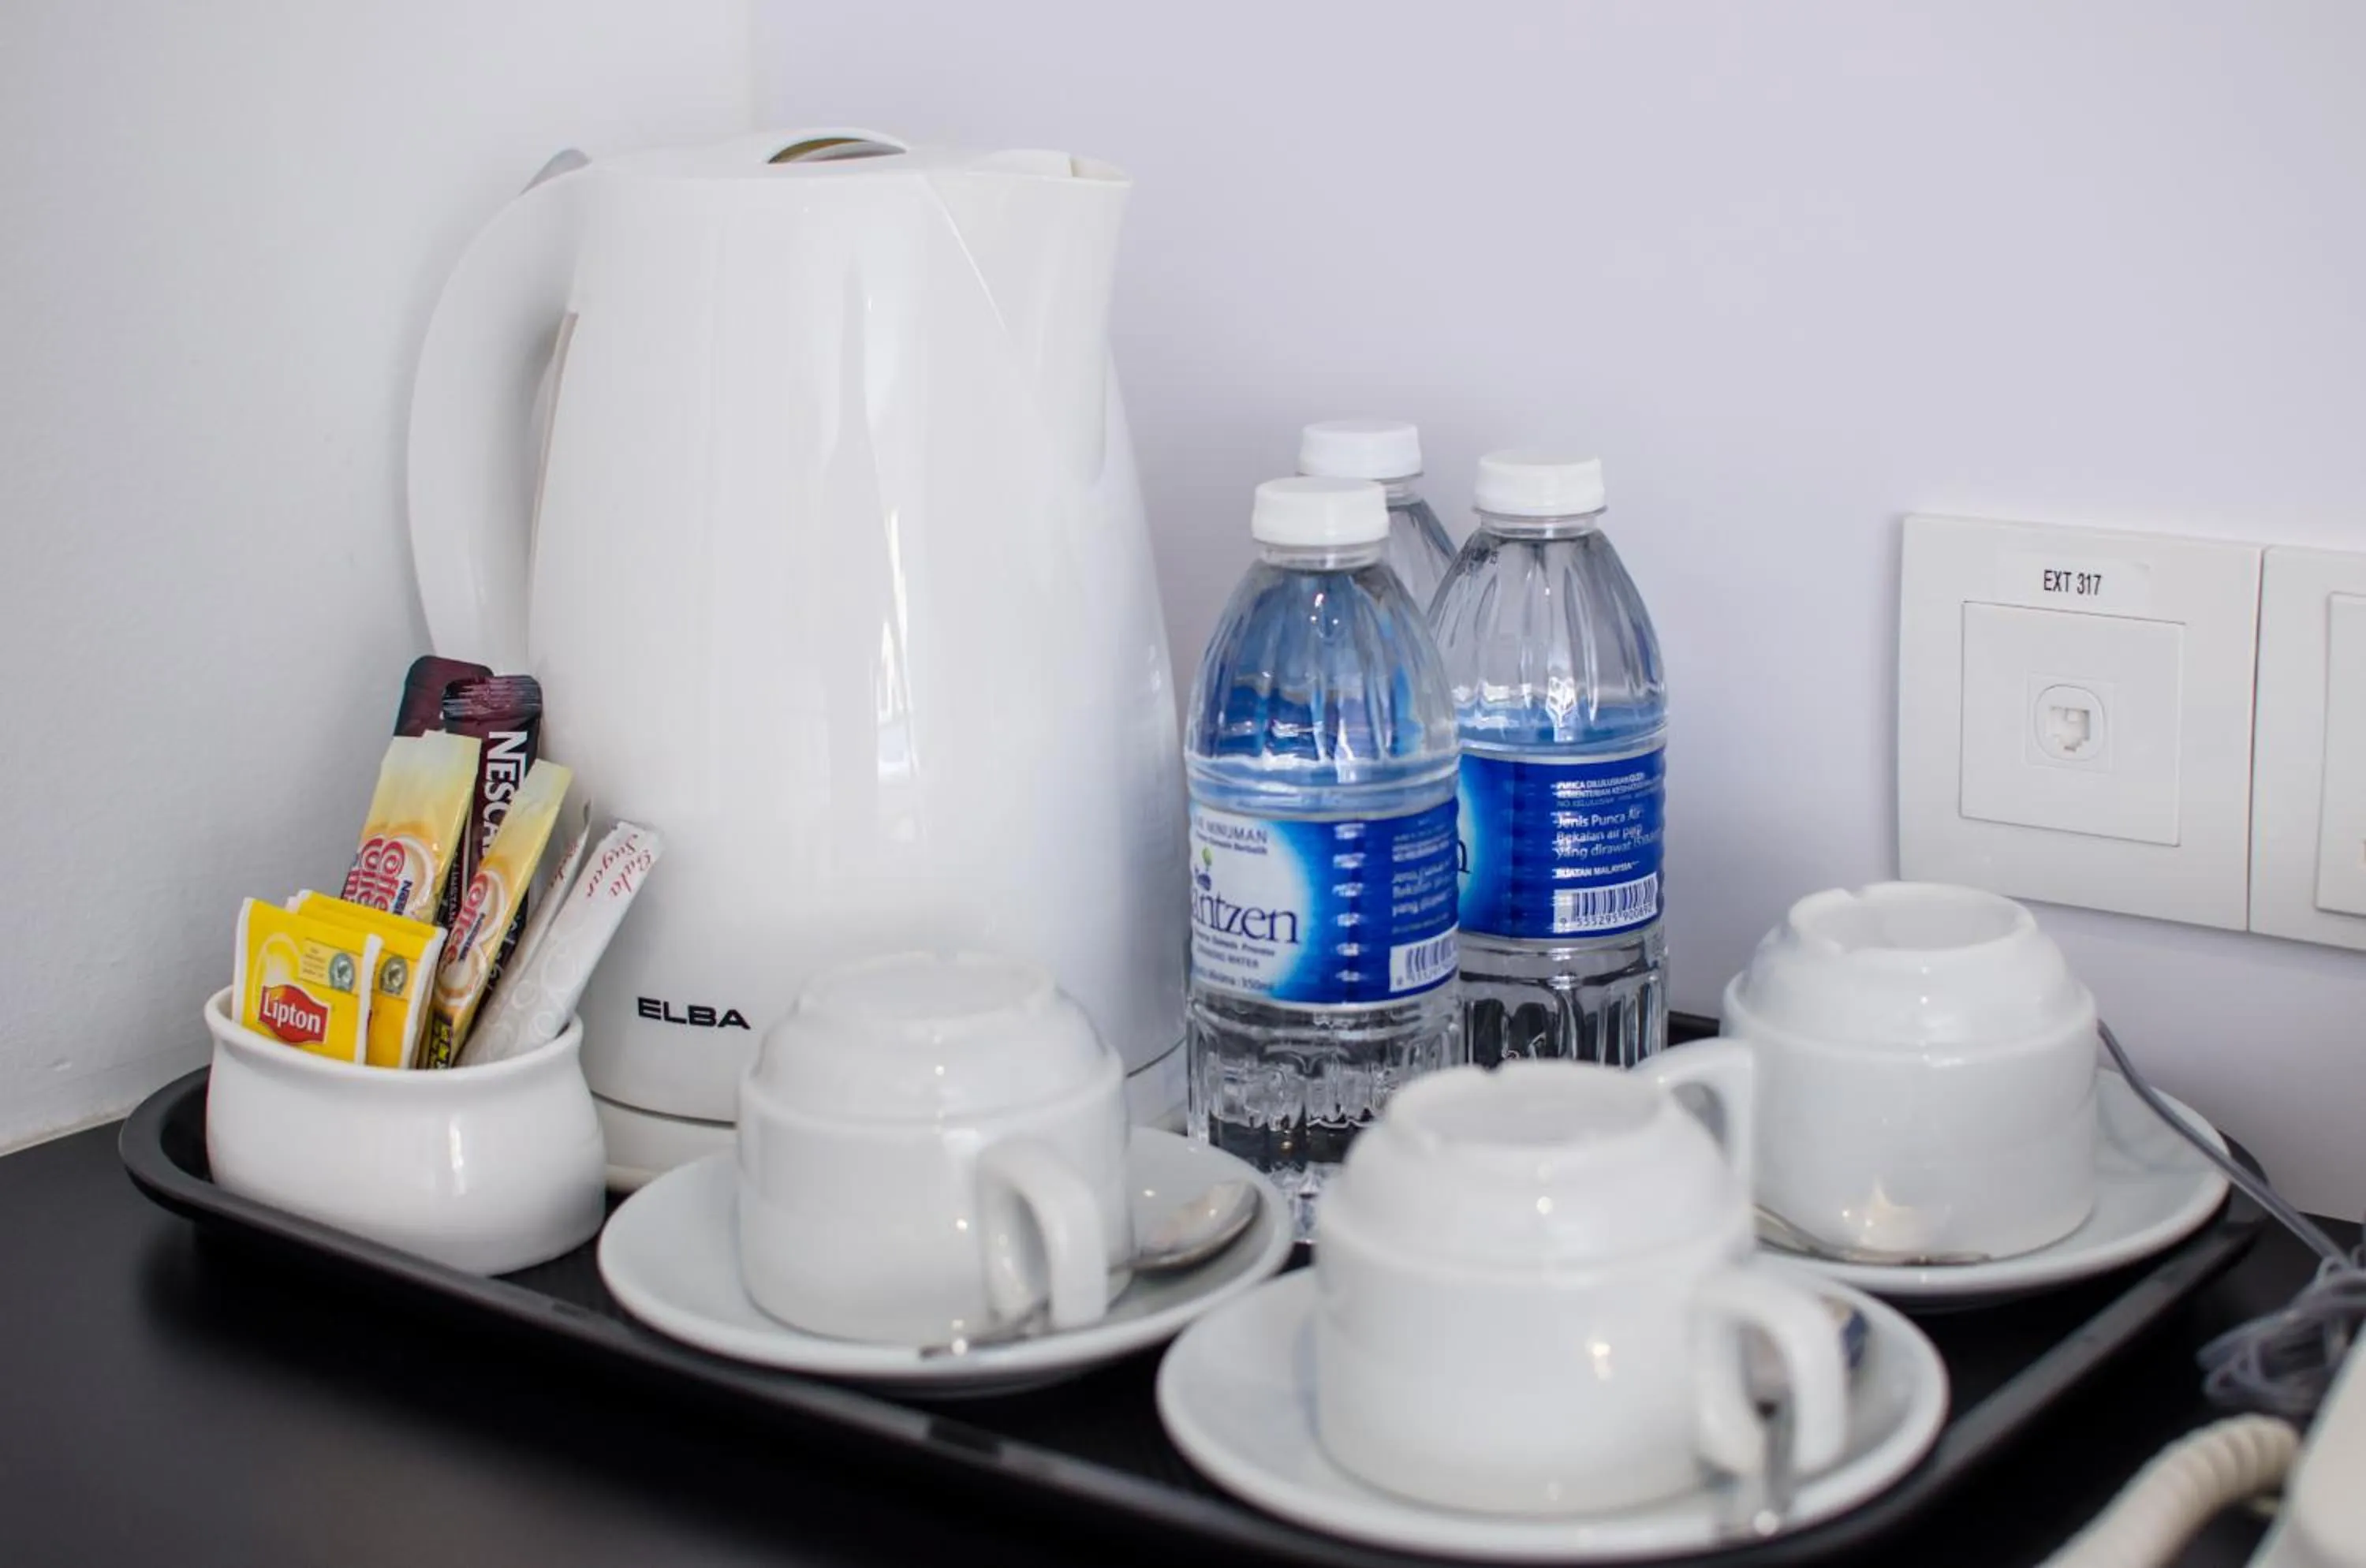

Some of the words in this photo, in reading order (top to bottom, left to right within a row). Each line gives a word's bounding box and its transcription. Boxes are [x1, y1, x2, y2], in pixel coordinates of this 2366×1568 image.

[2043, 569, 2072, 592] EXT
[2077, 573, 2102, 595] 317
[1591, 812, 1625, 827] Punca
[1556, 827, 1605, 844] Bekalan
[1557, 844, 1588, 861] yang
[1590, 841, 1631, 856] dirawat
[372, 841, 405, 910] Coffe
[1593, 861, 1635, 876] MALAYSIA
[263, 991, 322, 1034] Lipton
[637, 996, 751, 1030] ELBA
